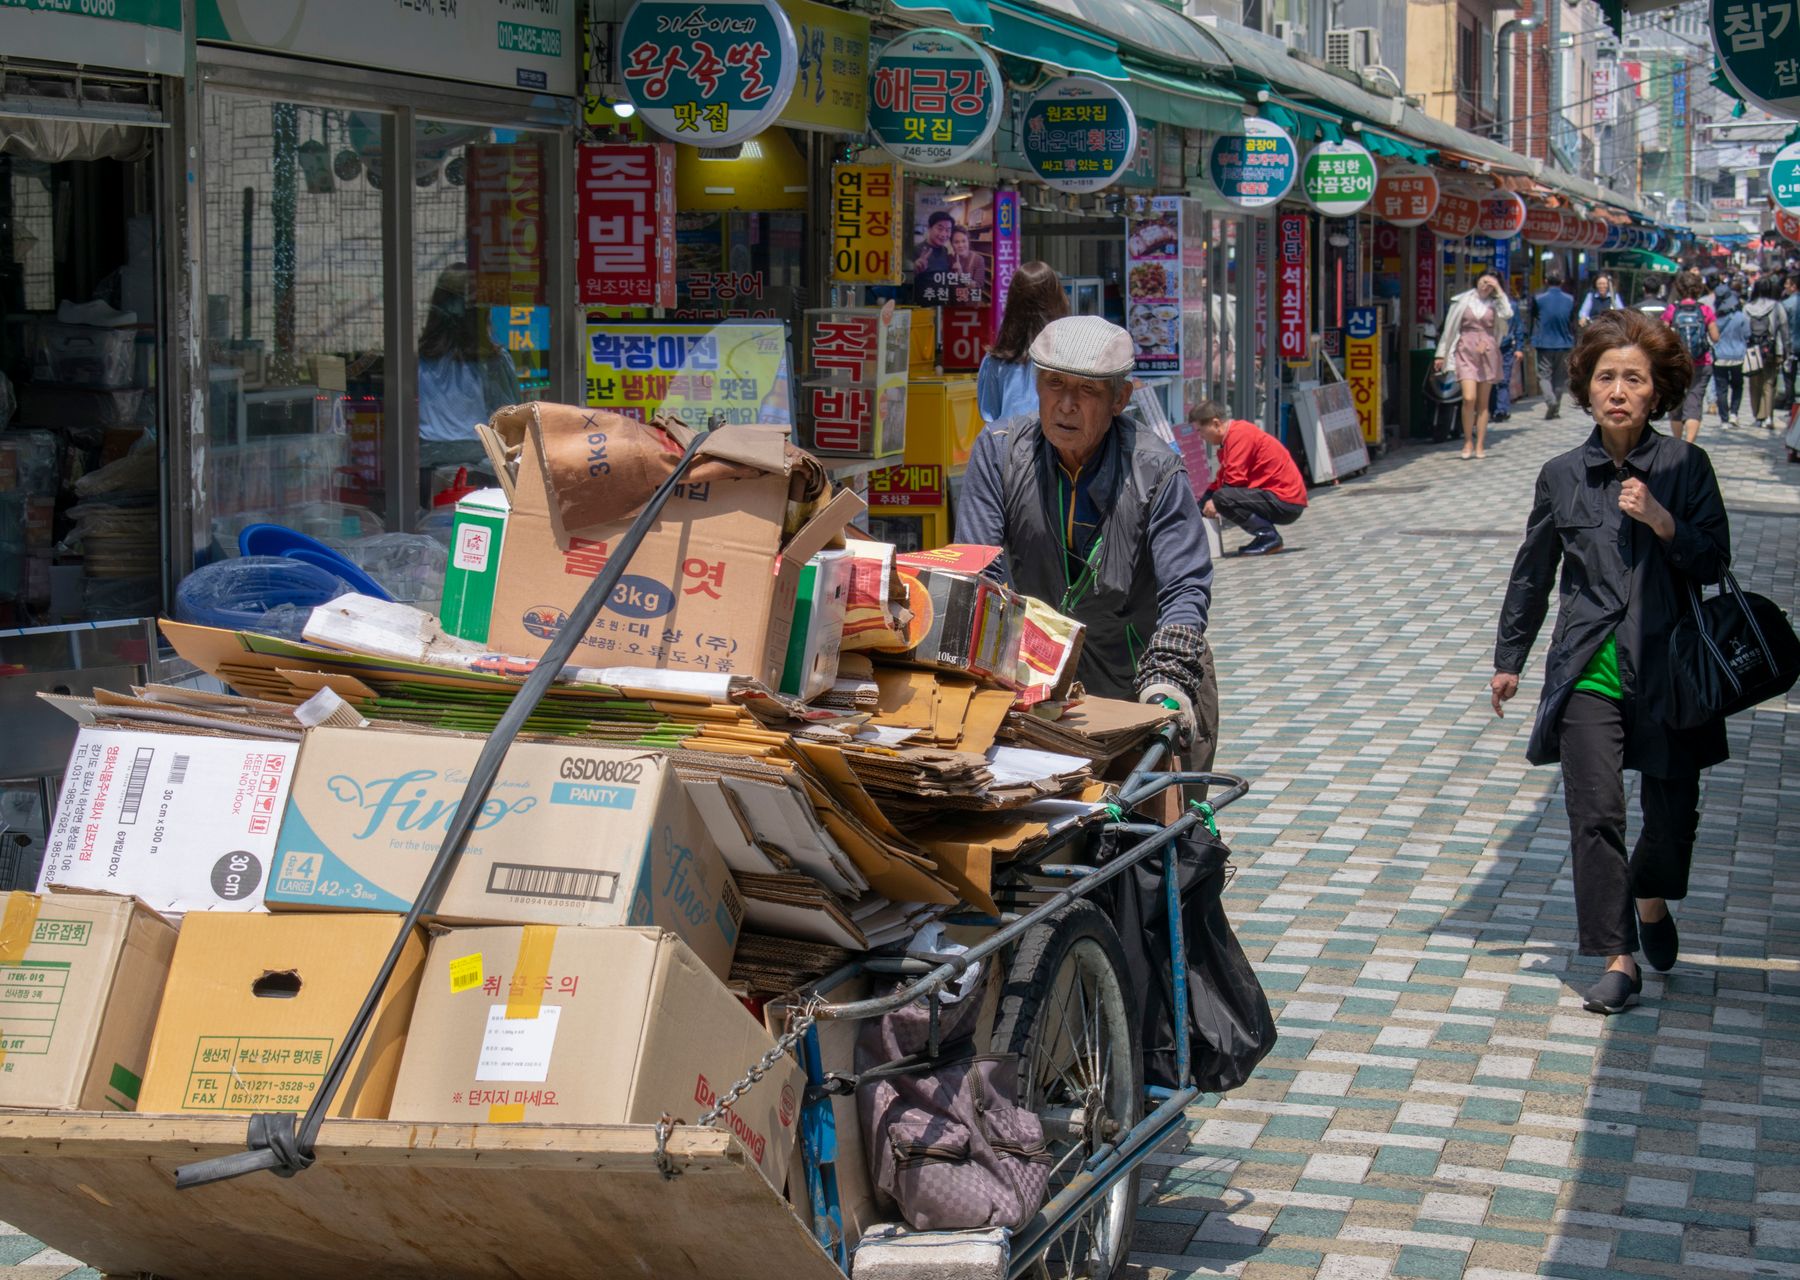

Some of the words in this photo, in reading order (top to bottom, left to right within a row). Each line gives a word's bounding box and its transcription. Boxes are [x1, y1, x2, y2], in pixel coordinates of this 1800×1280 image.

[623, 41, 773, 100] 왕족발
[874, 66, 988, 116] 해금강
[674, 101, 730, 132] 맛집
[1046, 105, 1107, 122] 원조맛집
[903, 118, 953, 142] 맛집
[1028, 128, 1125, 153] 해운대횟집
[903, 147, 951, 157] 746-5054
[1318, 160, 1361, 174] 푸짐한
[586, 154, 654, 273] 족발
[836, 171, 863, 275] 연탄구이
[865, 171, 892, 275] 곰장어
[1282, 219, 1303, 264] 연탄
[586, 278, 651, 297] 원조맛집
[688, 271, 764, 300] 곰장어
[933, 272, 973, 286] 이연복
[923, 288, 949, 302] 추천
[1281, 267, 1302, 354] 석쇠구이
[1348, 311, 1374, 335] 산
[951, 311, 981, 364] 구이
[591, 333, 719, 370] 확장이전
[621, 374, 714, 401] 냉채족발
[720, 377, 758, 400] 맛집
[812, 321, 868, 452] 족발
[1350, 343, 1375, 436] 곰장어
[587, 432, 611, 479] 3kg
[612, 583, 659, 613] 3kg
[696, 633, 739, 654] (주)
[937, 651, 957, 665] 10kg
[87, 744, 102, 768] 경기도
[245, 753, 254, 771] USE
[252, 753, 264, 779] KEEP
[241, 773, 249, 784] NO
[559, 756, 644, 785] GSD08022
[80, 771, 94, 795] 김포시
[89, 746, 120, 820] 영화식품주식회사
[248, 780, 258, 797] DRY
[163, 789, 174, 801] 30
[232, 787, 246, 815] HOOK
[568, 787, 618, 803] PANTY
[158, 803, 168, 818] cm
[79, 823, 100, 862] 김포지점
[152, 826, 164, 843] 500
[389, 839, 404, 850] For
[405, 840, 419, 851] the
[421, 841, 441, 853] love
[61, 854, 73, 871] 106
[229, 854, 249, 872] 30
[297, 855, 314, 878] 4
[224, 874, 241, 896] cm
[281, 879, 311, 891] LARGE
[35, 922, 86, 942] 섬유잡화
[10, 1039, 25, 1049] SET
[202, 1048, 231, 1063] 생산지
[238, 1049, 259, 1063] 부산
[261, 1049, 290, 1064] 강서구
[293, 1049, 323, 1064] 명지동
[197, 1079, 218, 1090] TEL
[234, 1080, 316, 1092] 051)271-3528~9
[191, 1093, 217, 1104] FAX
[231, 1094, 300, 1105] 051)271-3524
[468, 1089, 510, 1106] 던지지
[514, 1089, 560, 1106] 마세요.
